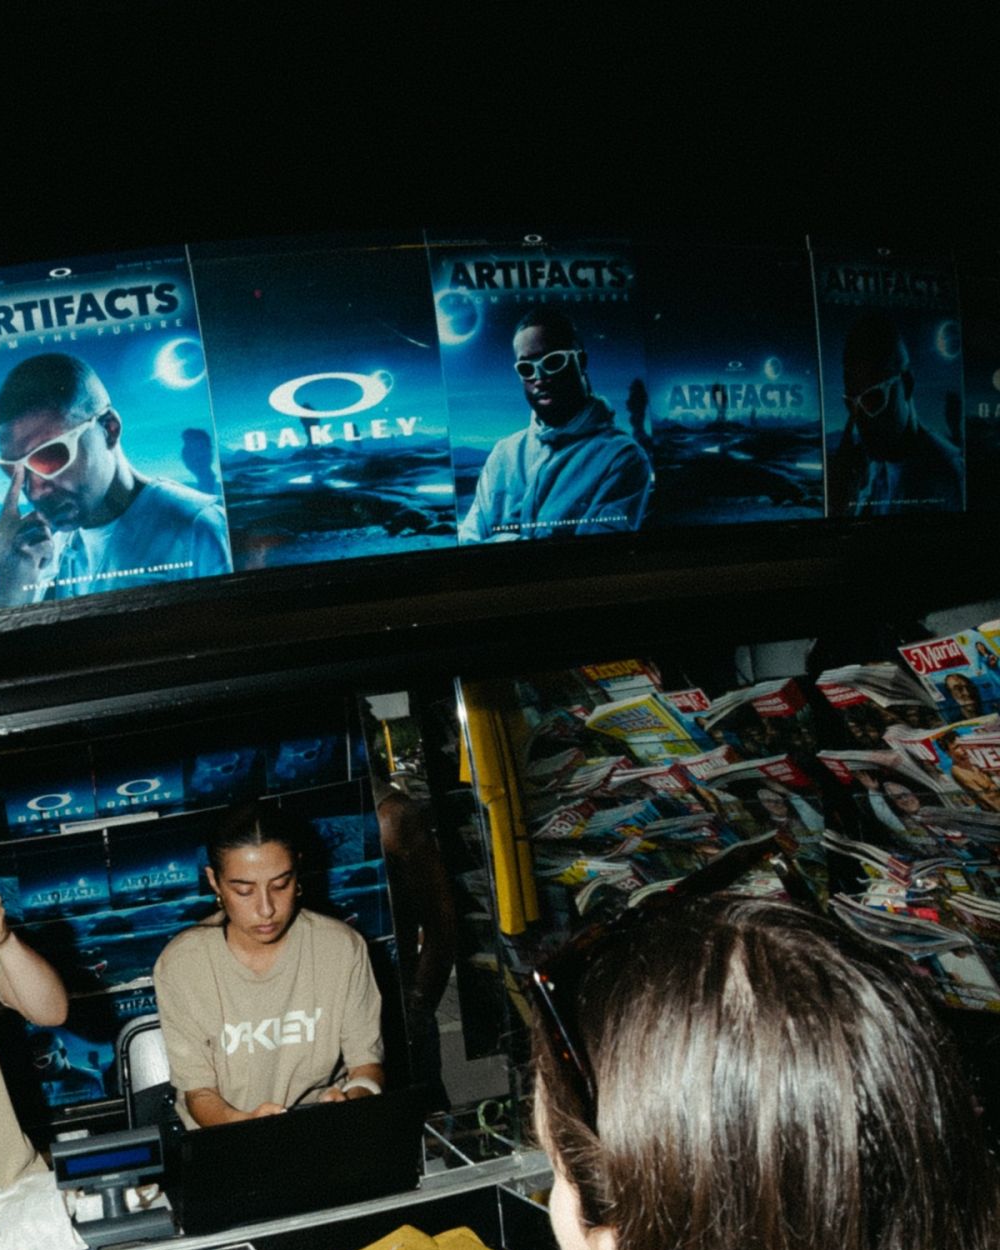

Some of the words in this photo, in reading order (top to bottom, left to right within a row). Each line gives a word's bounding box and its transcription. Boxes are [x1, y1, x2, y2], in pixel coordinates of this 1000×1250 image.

[449, 259, 627, 290] ARTIFACTS
[38, 331, 77, 345] THE
[96, 318, 182, 337] FUTURE
[244, 417, 418, 452] OAKLEY
[910, 642, 962, 675] Maria
[18, 806, 84, 823] OAKLEY
[106, 791, 171, 809] OAKLEY
[220, 1007, 324, 1056] OAKLEY
